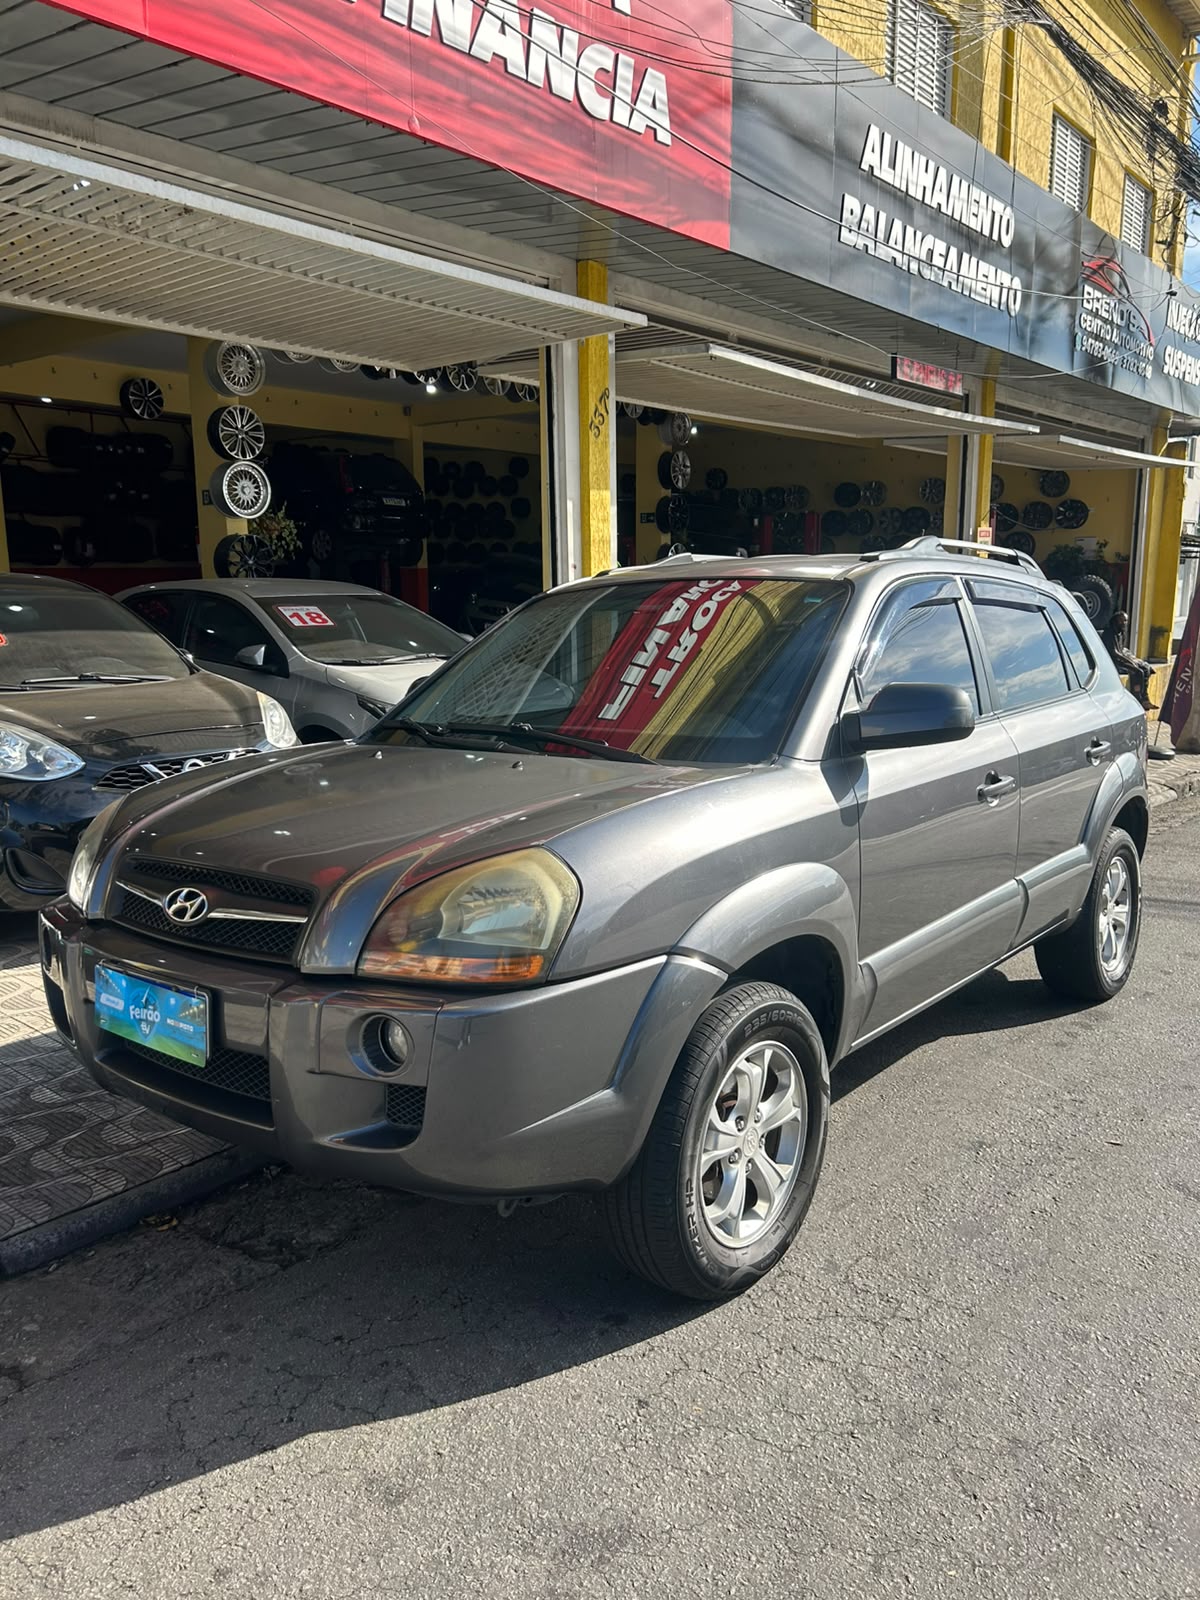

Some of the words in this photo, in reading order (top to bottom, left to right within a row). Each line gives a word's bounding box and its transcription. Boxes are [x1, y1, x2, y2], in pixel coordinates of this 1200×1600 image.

[859, 123, 1015, 248] ALINHAMENTO
[838, 192, 1022, 318] BALANCEAMENTO
[1080, 312, 1111, 340] CENTRO
[288, 611, 329, 625] 18
[129, 1004, 161, 1023] Feirão
[686, 1177, 695, 1208] HP
